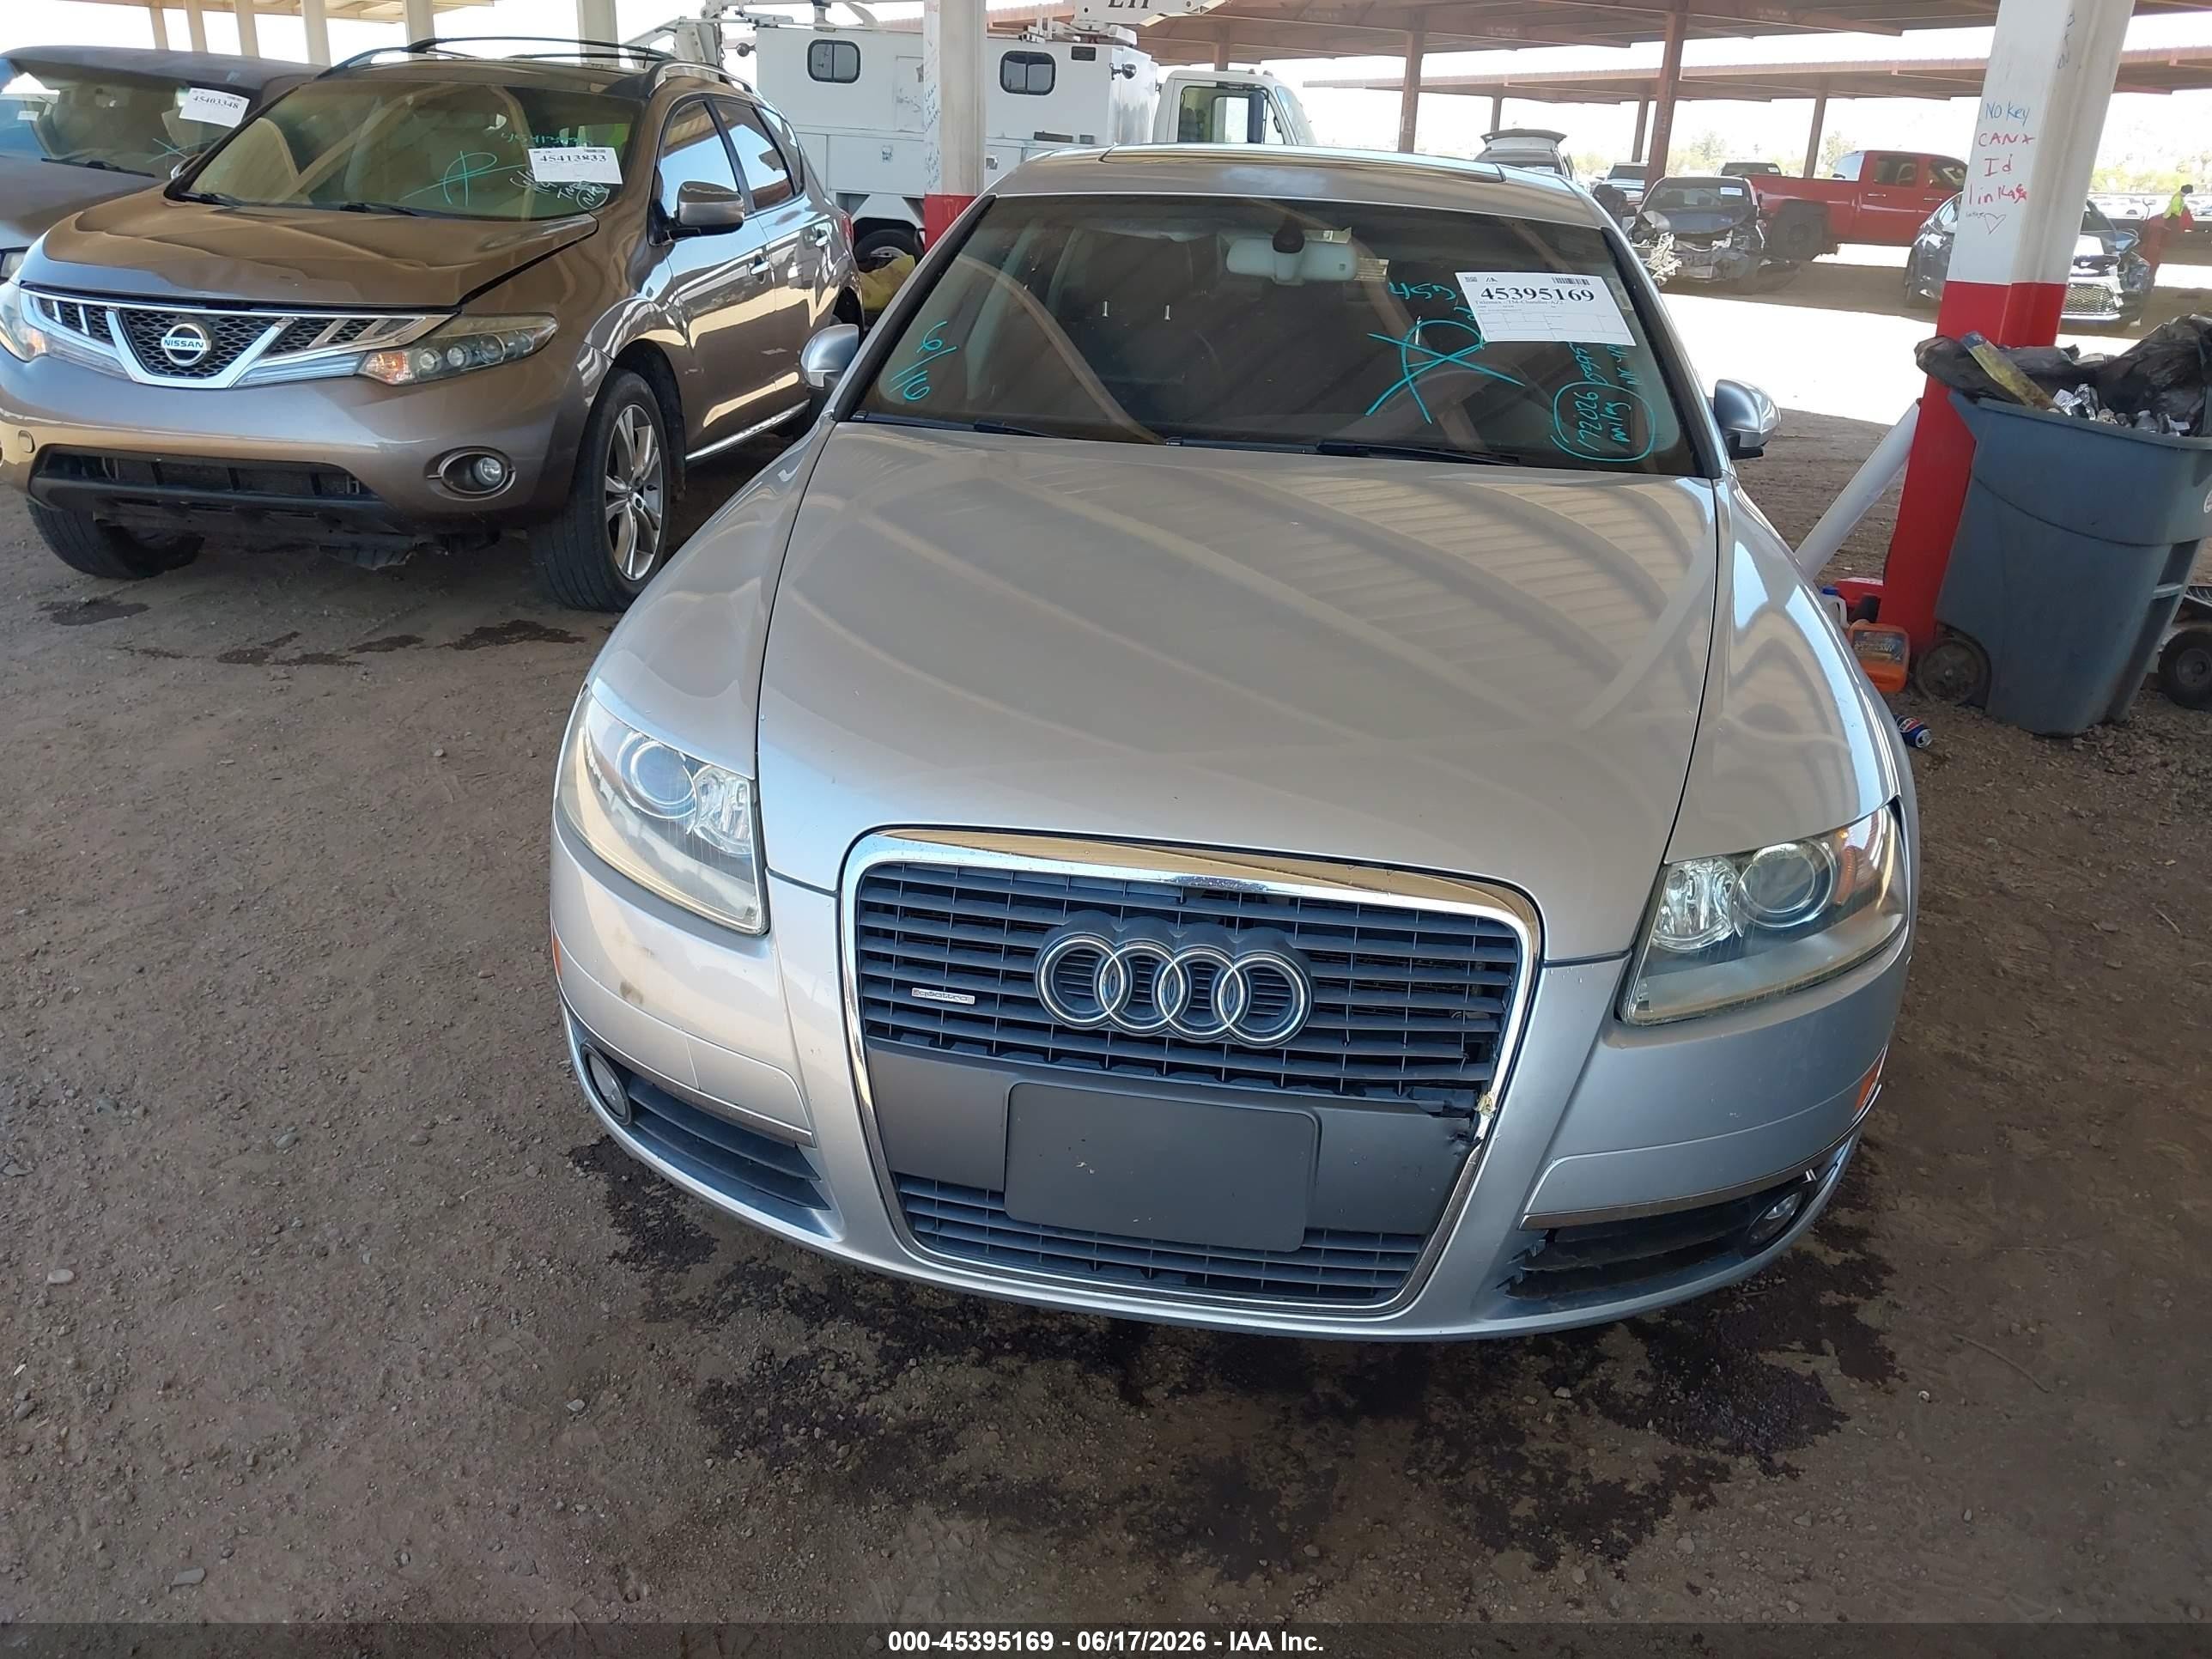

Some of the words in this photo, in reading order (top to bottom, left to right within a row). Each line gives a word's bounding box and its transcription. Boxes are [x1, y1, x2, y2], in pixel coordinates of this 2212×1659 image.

[540, 155, 607, 163] 45413833
[1480, 287, 1595, 301] 45395169
[164, 339, 204, 348] NISSAN
